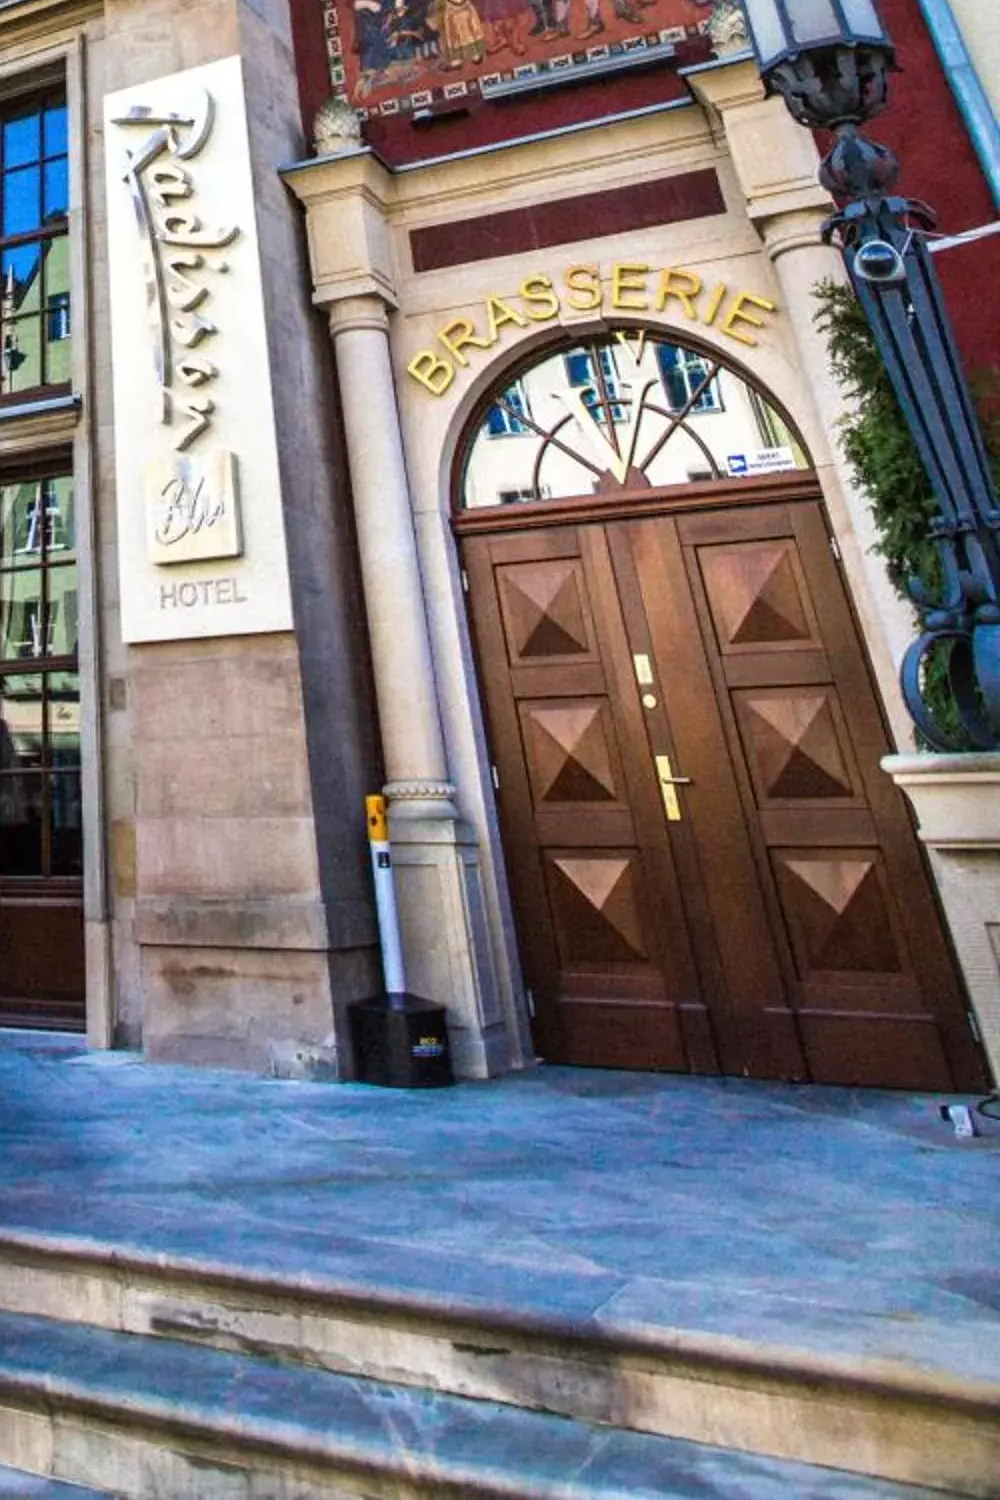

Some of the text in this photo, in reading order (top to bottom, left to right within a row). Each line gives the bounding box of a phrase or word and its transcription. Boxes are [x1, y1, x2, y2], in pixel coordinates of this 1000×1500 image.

[110, 85, 242, 451] Radisson
[407, 262, 777, 397] BRASSERIE
[154, 476, 226, 545] Blu
[158, 577, 248, 610] HOTEL
